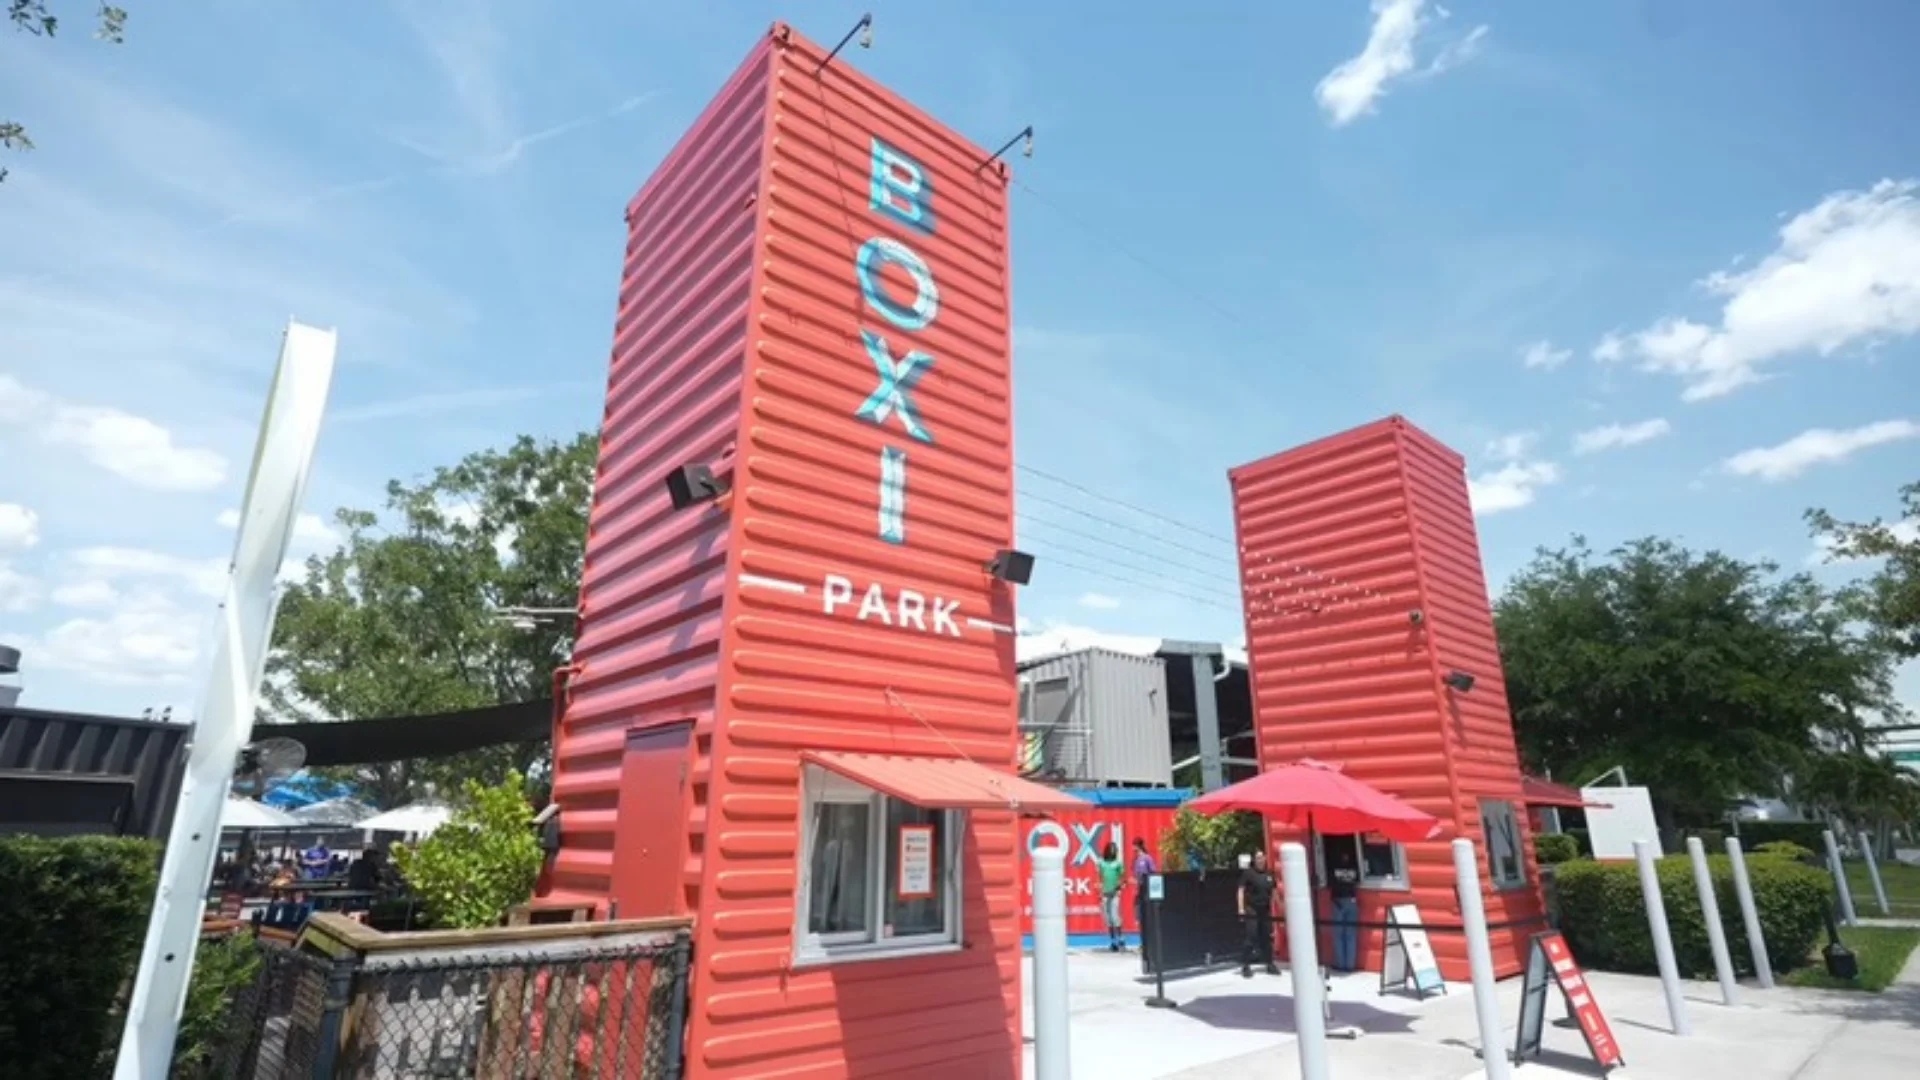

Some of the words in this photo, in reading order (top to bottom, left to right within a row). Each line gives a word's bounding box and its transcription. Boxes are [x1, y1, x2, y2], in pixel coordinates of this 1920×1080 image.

[855, 136, 940, 545] BOXI
[822, 573, 962, 638] PARK
[1027, 820, 1125, 868] OXI
